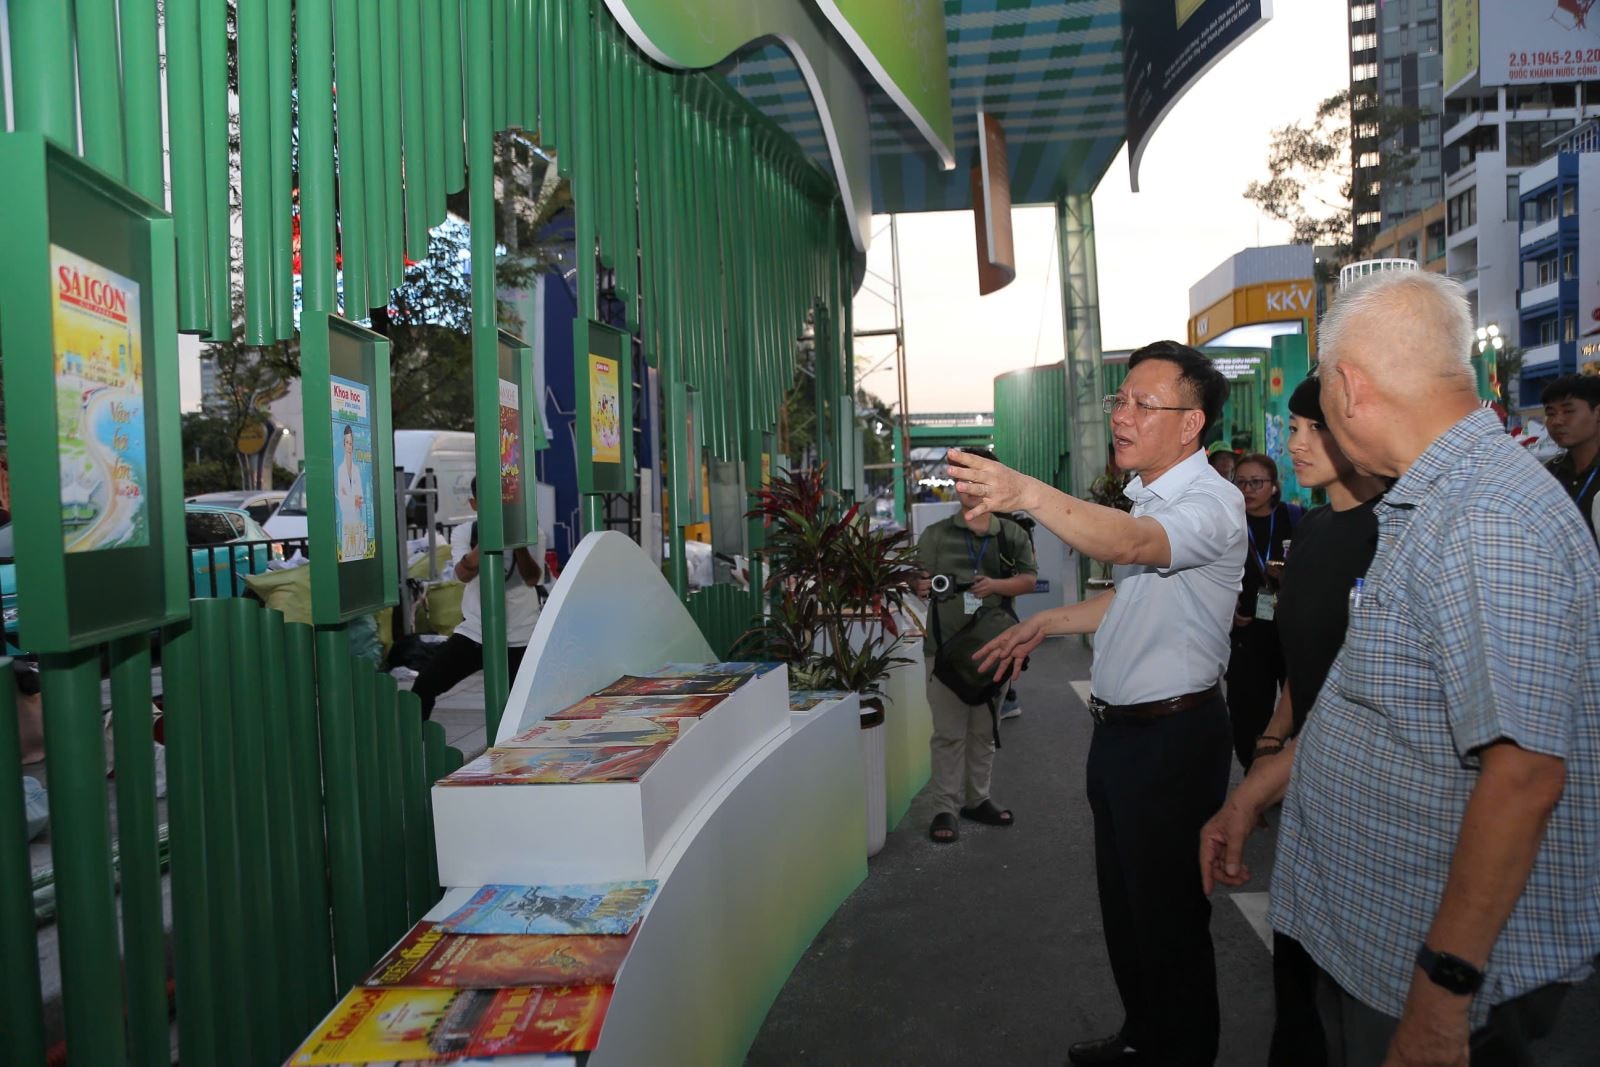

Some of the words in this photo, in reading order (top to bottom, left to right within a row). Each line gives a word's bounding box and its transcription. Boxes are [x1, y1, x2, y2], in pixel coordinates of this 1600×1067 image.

[1266, 283, 1313, 312] KKV
[333, 384, 349, 400] Khoa
[350, 389, 360, 402] học
